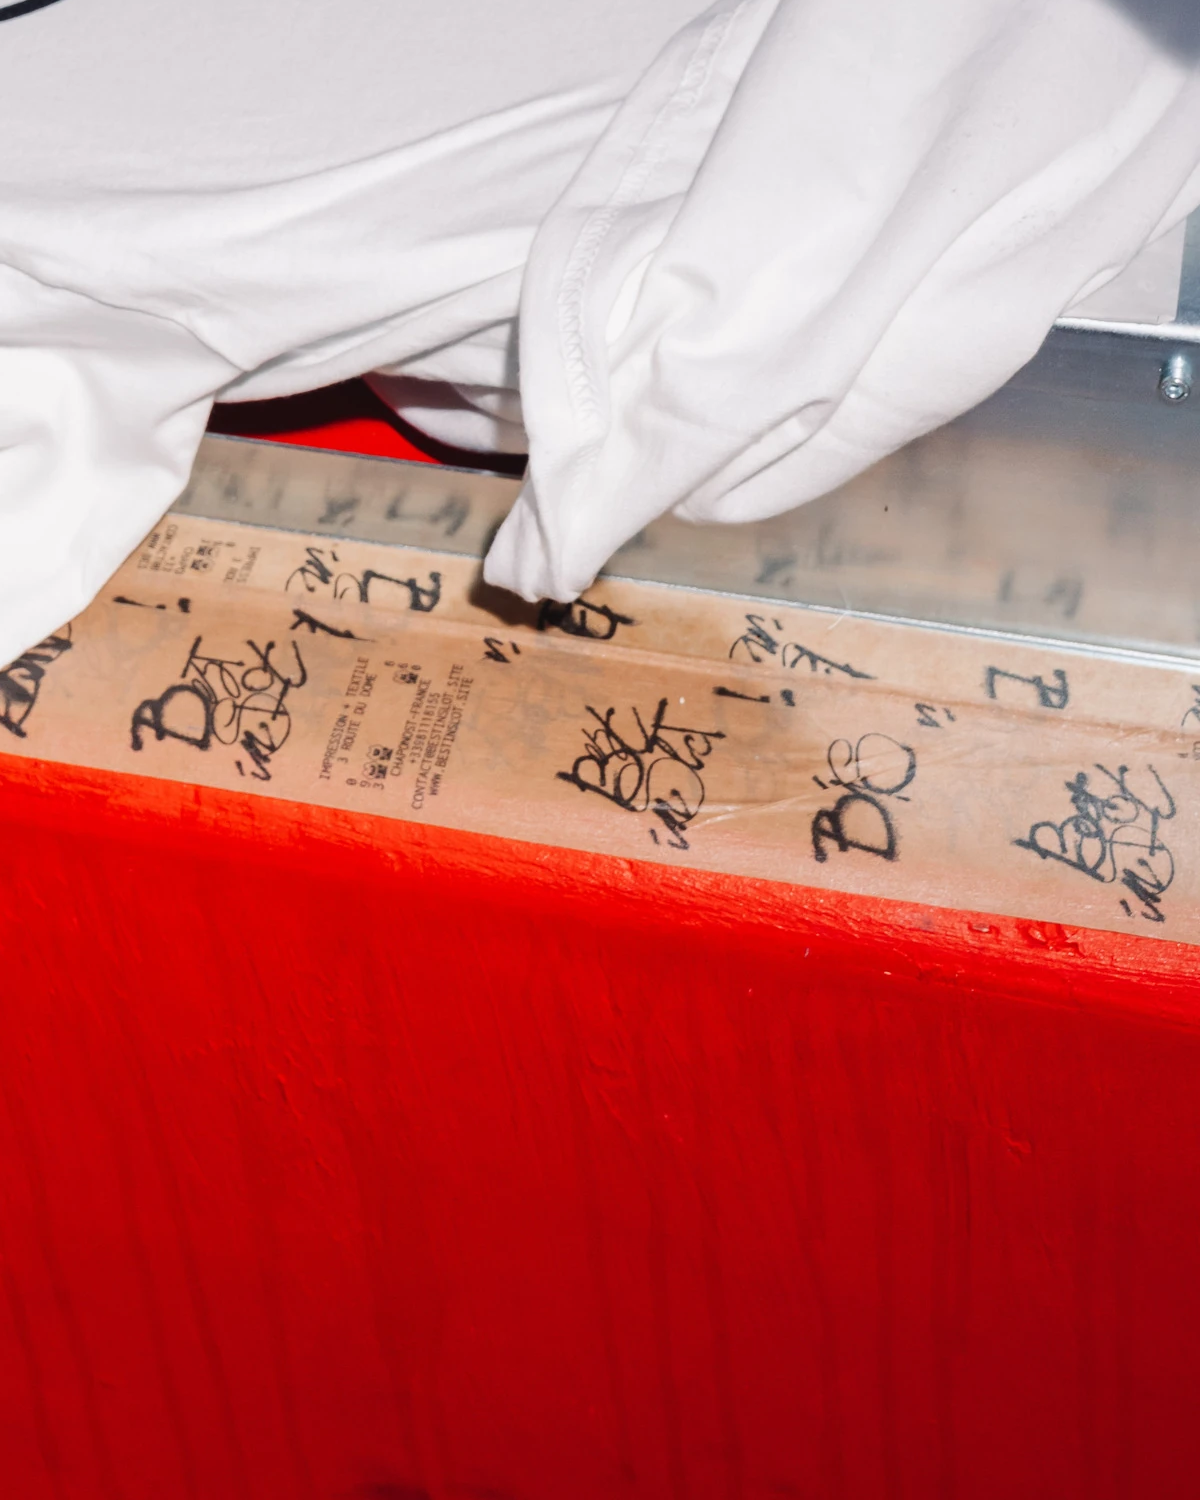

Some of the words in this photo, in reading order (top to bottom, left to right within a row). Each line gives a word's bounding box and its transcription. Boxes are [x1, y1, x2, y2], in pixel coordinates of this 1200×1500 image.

[359, 673, 378, 698] DOME
[319, 714, 348, 781] IMPRESSION
[345, 656, 370, 698] TEXTILE
[354, 701, 368, 716] DU
[341, 721, 362, 752] ROUTE
[411, 663, 465, 810] CONTACT@BESTINSLOT.SITE
